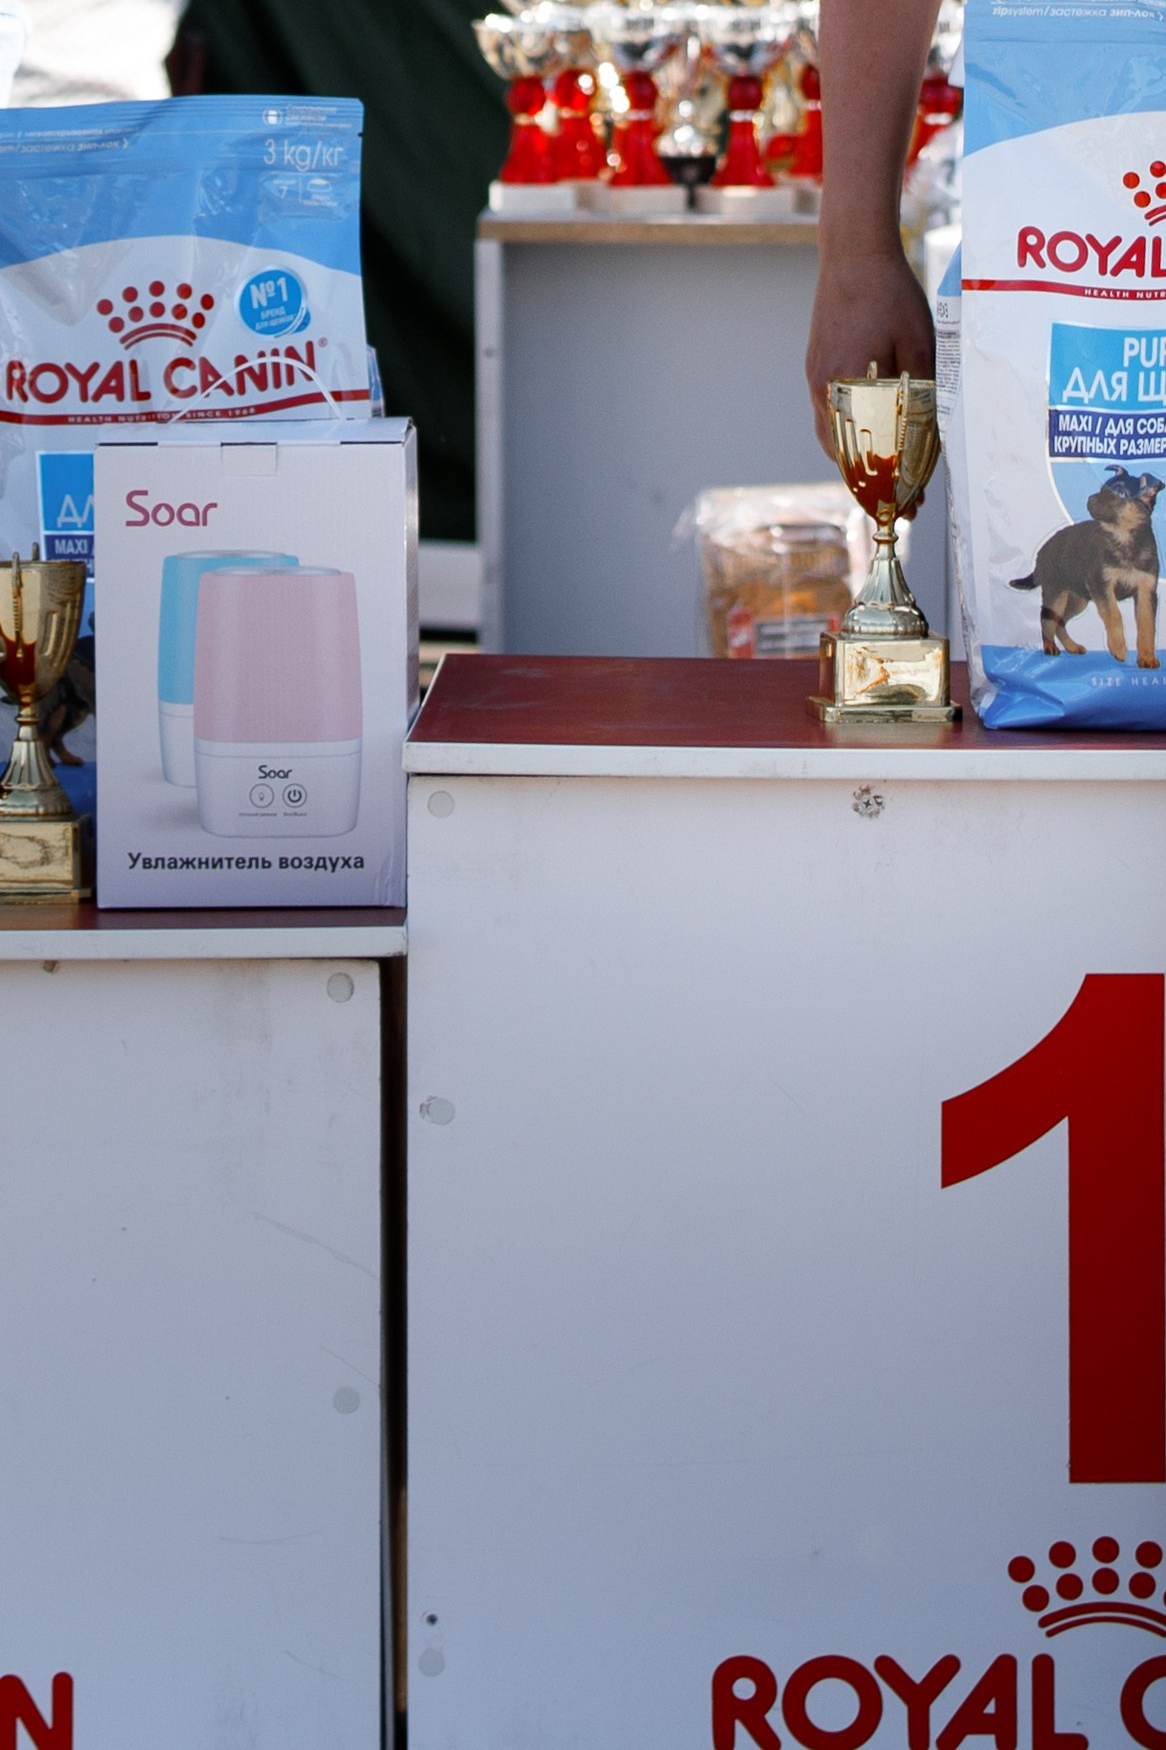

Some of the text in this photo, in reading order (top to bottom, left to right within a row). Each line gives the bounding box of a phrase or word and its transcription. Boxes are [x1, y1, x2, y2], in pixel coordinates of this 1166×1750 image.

[263, 138, 276, 165] 3
[1084, 287, 1129, 298] HEALTH
[6, 340, 316, 403] ROYAL CANIN
[1062, 366, 1127, 404] ДЛЯ
[68, 414, 111, 423] HEALTH
[1058, 414, 1093, 432] MAXI
[1105, 416, 1133, 437] ДЛЯ
[1054, 435, 1117, 455] КРУПНЫХ
[125, 490, 218, 527] Soar
[54, 539, 88, 554] MAXI
[1091, 676, 1121, 687] SIZE
[258, 764, 293, 779] Soar
[128, 852, 365, 874] Увлажнитель воздуха
[940, 973, 1166, 1483] 1
[712, 1654, 1089, 1750] ROYAL
